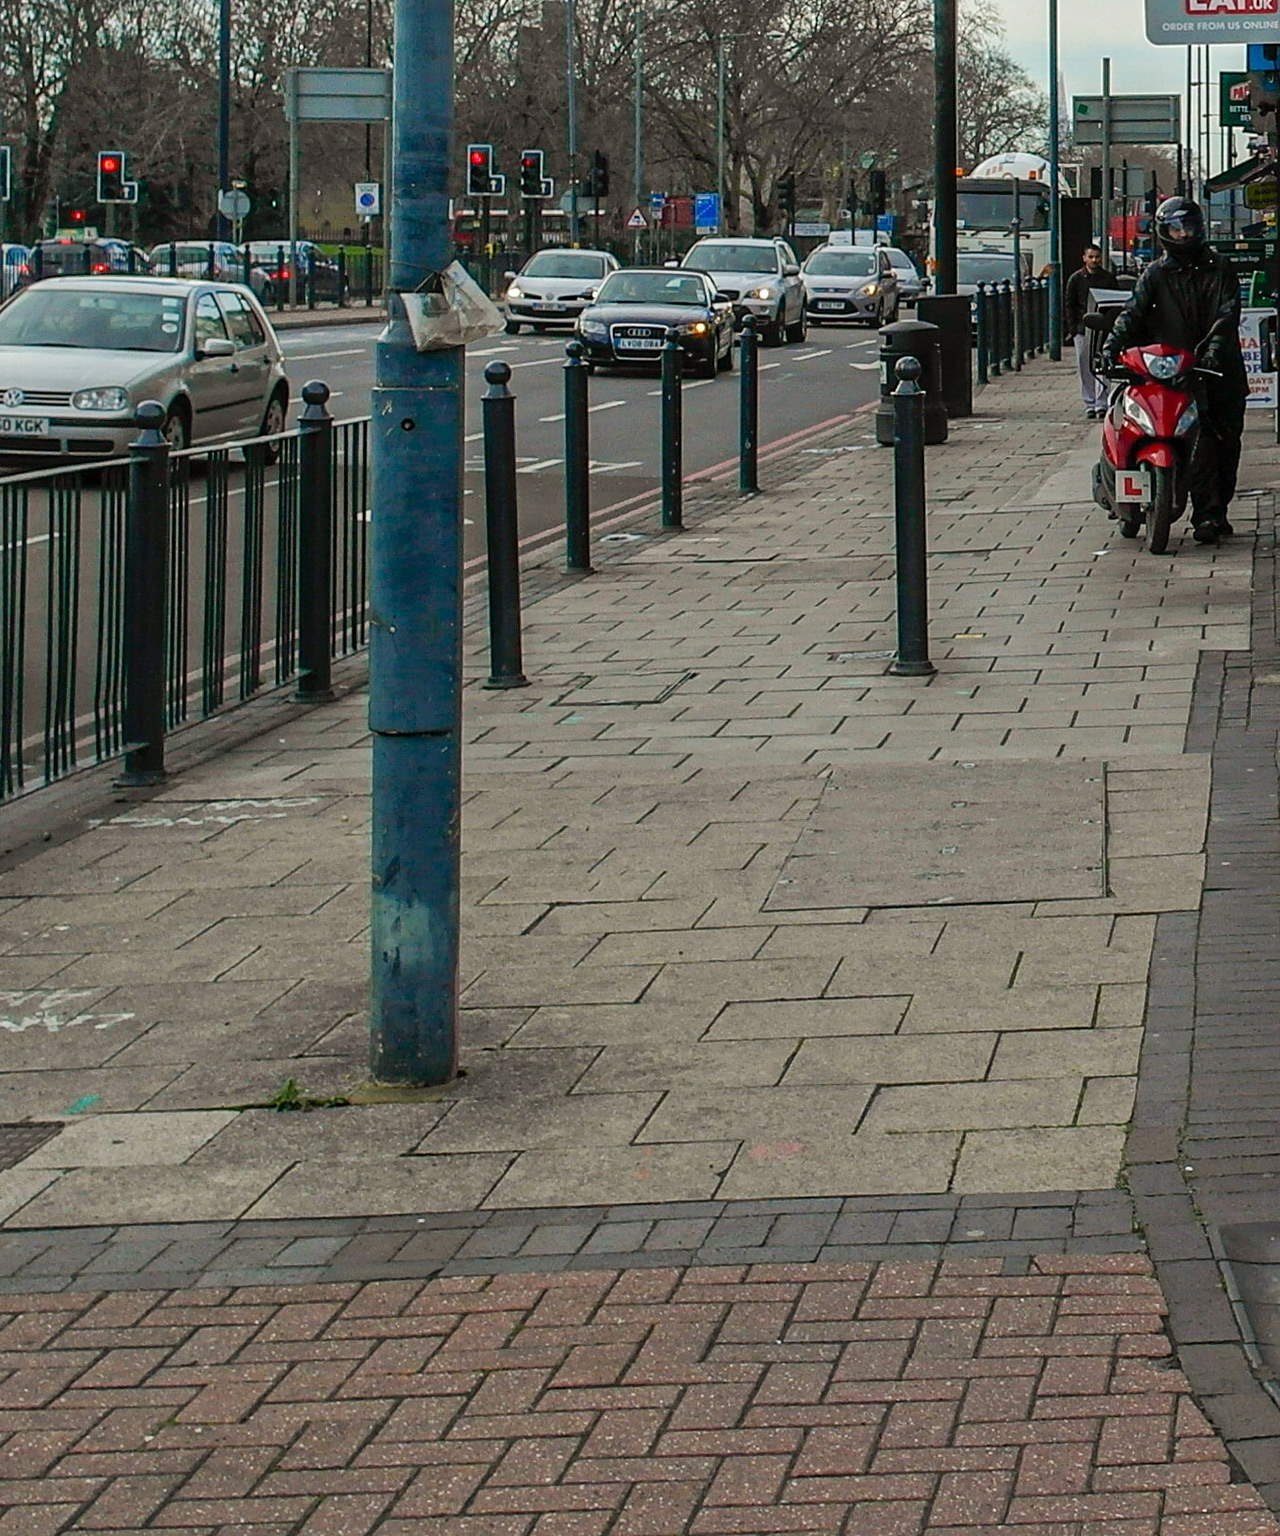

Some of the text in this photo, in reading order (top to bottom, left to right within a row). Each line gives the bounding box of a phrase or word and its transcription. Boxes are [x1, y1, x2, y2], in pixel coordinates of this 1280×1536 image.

[1162, 20, 1279, 31] ORDER FROM US ONLINE
[15, 419, 43, 432] KGK
[1124, 477, 1142, 495] L
